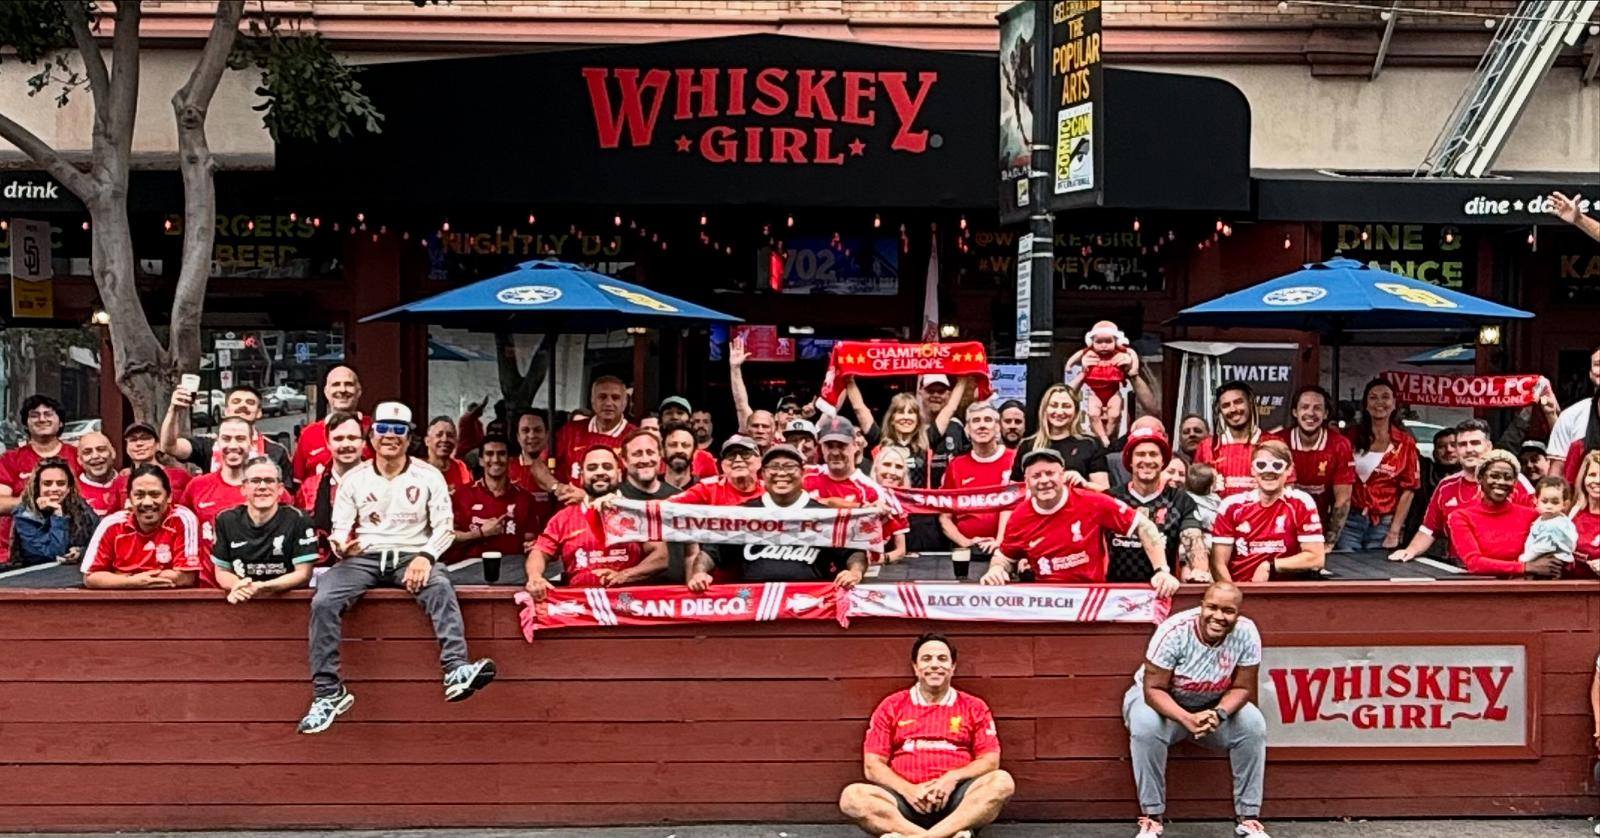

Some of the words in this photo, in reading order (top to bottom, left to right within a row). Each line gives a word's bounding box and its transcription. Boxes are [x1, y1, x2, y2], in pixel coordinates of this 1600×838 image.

[1067, 16, 1084, 40] THE
[1052, 33, 1100, 76] POPULAR
[1061, 68, 1090, 106] ARTS
[582, 68, 937, 153] WHISKEY
[1071, 113, 1090, 138] CON
[700, 126, 844, 165] GIRL
[1058, 119, 1072, 179] COMIC
[3, 180, 59, 199] drink
[1464, 196, 1510, 215] dine
[163, 213, 315, 239] BRGERS
[1338, 224, 1423, 251] DINE
[866, 344, 950, 360] CHAMPIONS
[872, 359, 891, 371] OF
[893, 358, 944, 370] EUROPE
[1222, 364, 1290, 382] TWATER
[1387, 372, 1503, 397] IVERPOOL
[1504, 376, 1534, 396] FC
[1416, 394, 1451, 405] NEVER
[911, 493, 953, 508] SAN
[957, 491, 1016, 508] DIEGO
[672, 516, 791, 533] LIVERPOOL
[801, 520, 823, 533] FC
[743, 543, 821, 565] Candy
[629, 600, 675, 617] SAN
[681, 597, 747, 617] DIEGO
[927, 595, 965, 608] BACK
[970, 595, 993, 608] ON
[995, 595, 1025, 608] OUR
[1028, 596, 1074, 609] PERCH
[1268, 665, 1513, 724] WHISKEY
[1352, 704, 1452, 729] GIRL
